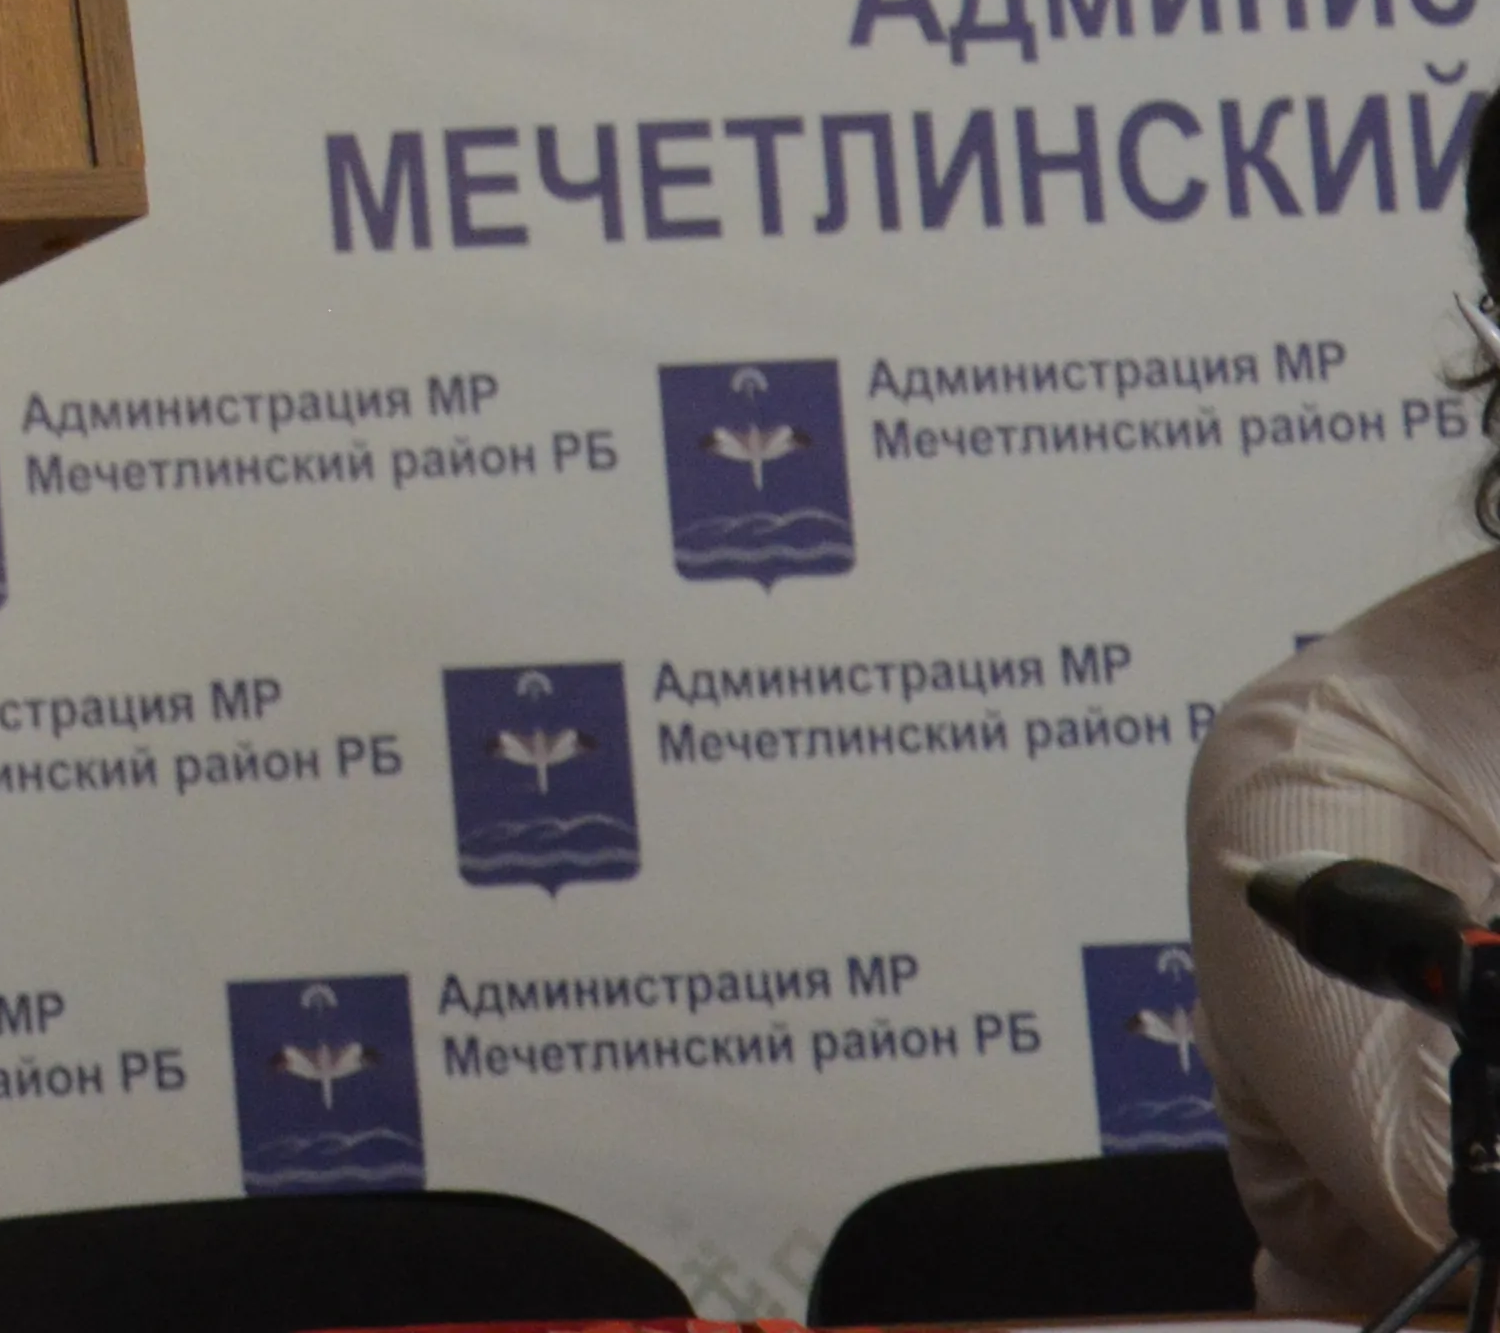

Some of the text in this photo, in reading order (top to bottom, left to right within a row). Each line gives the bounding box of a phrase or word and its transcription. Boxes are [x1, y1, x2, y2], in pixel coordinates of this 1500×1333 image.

[868, 341, 1347, 403] Администрация МР
[22, 373, 498, 435] Администрация МР
[873, 398, 1469, 461] Мечетлинский район РБ
[25, 430, 618, 496] Мечетлинский район РБ
[210, 677, 281, 720] МР
[653, 642, 1132, 705] Администрация МР
[176, 744, 320, 795] район
[338, 735, 403, 778] РБ
[657, 711, 1008, 766] Мечетлинский
[1025, 705, 1172, 760] район
[438, 954, 919, 1019] Администрация МР
[121, 1049, 187, 1092] РБ
[442, 1012, 1042, 1077] Мечетлинский район РБ
